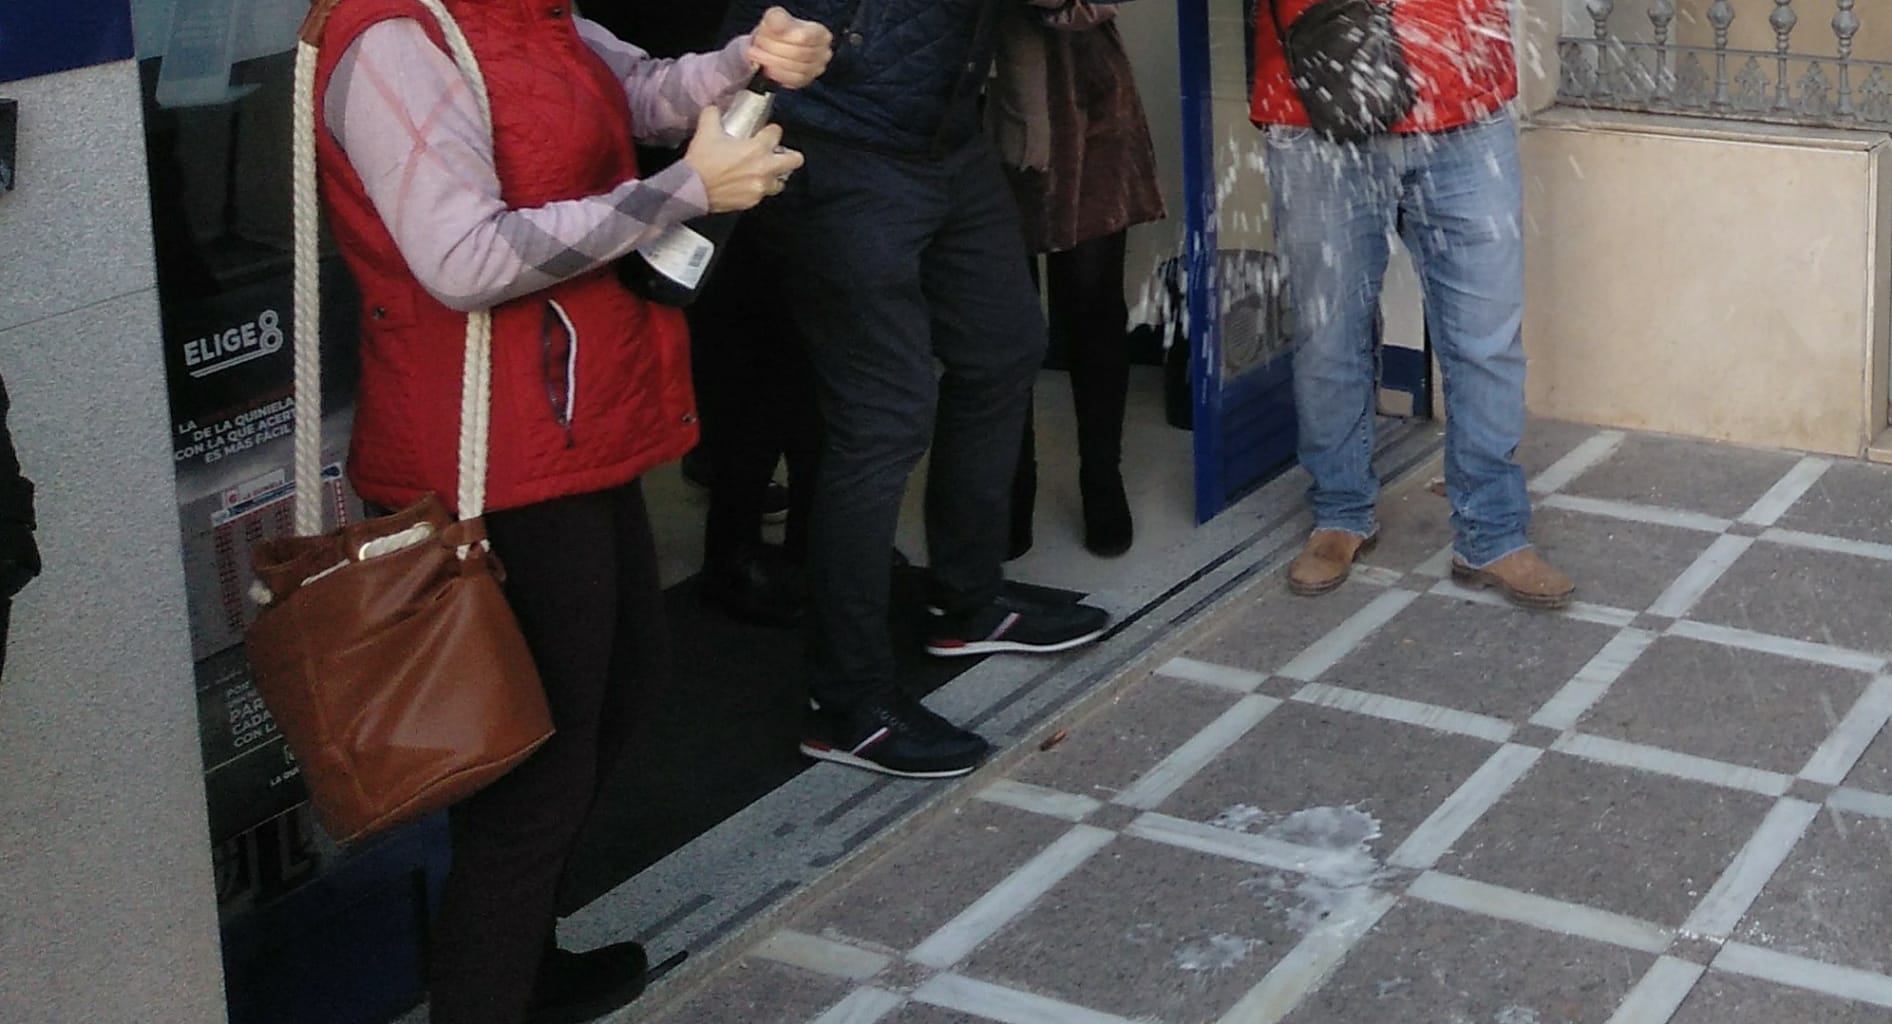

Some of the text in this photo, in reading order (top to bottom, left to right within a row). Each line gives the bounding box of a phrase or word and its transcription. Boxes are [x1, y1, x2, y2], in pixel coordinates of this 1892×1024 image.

[178, 419, 198, 435] LA
[193, 397, 295, 442] DE LA QUINIELA
[175, 442, 204, 461] CON
[207, 437, 225, 450] LA
[227, 426, 255, 443] QUE
[204, 449, 223, 464] ES
[233, 728, 262, 748] CON
